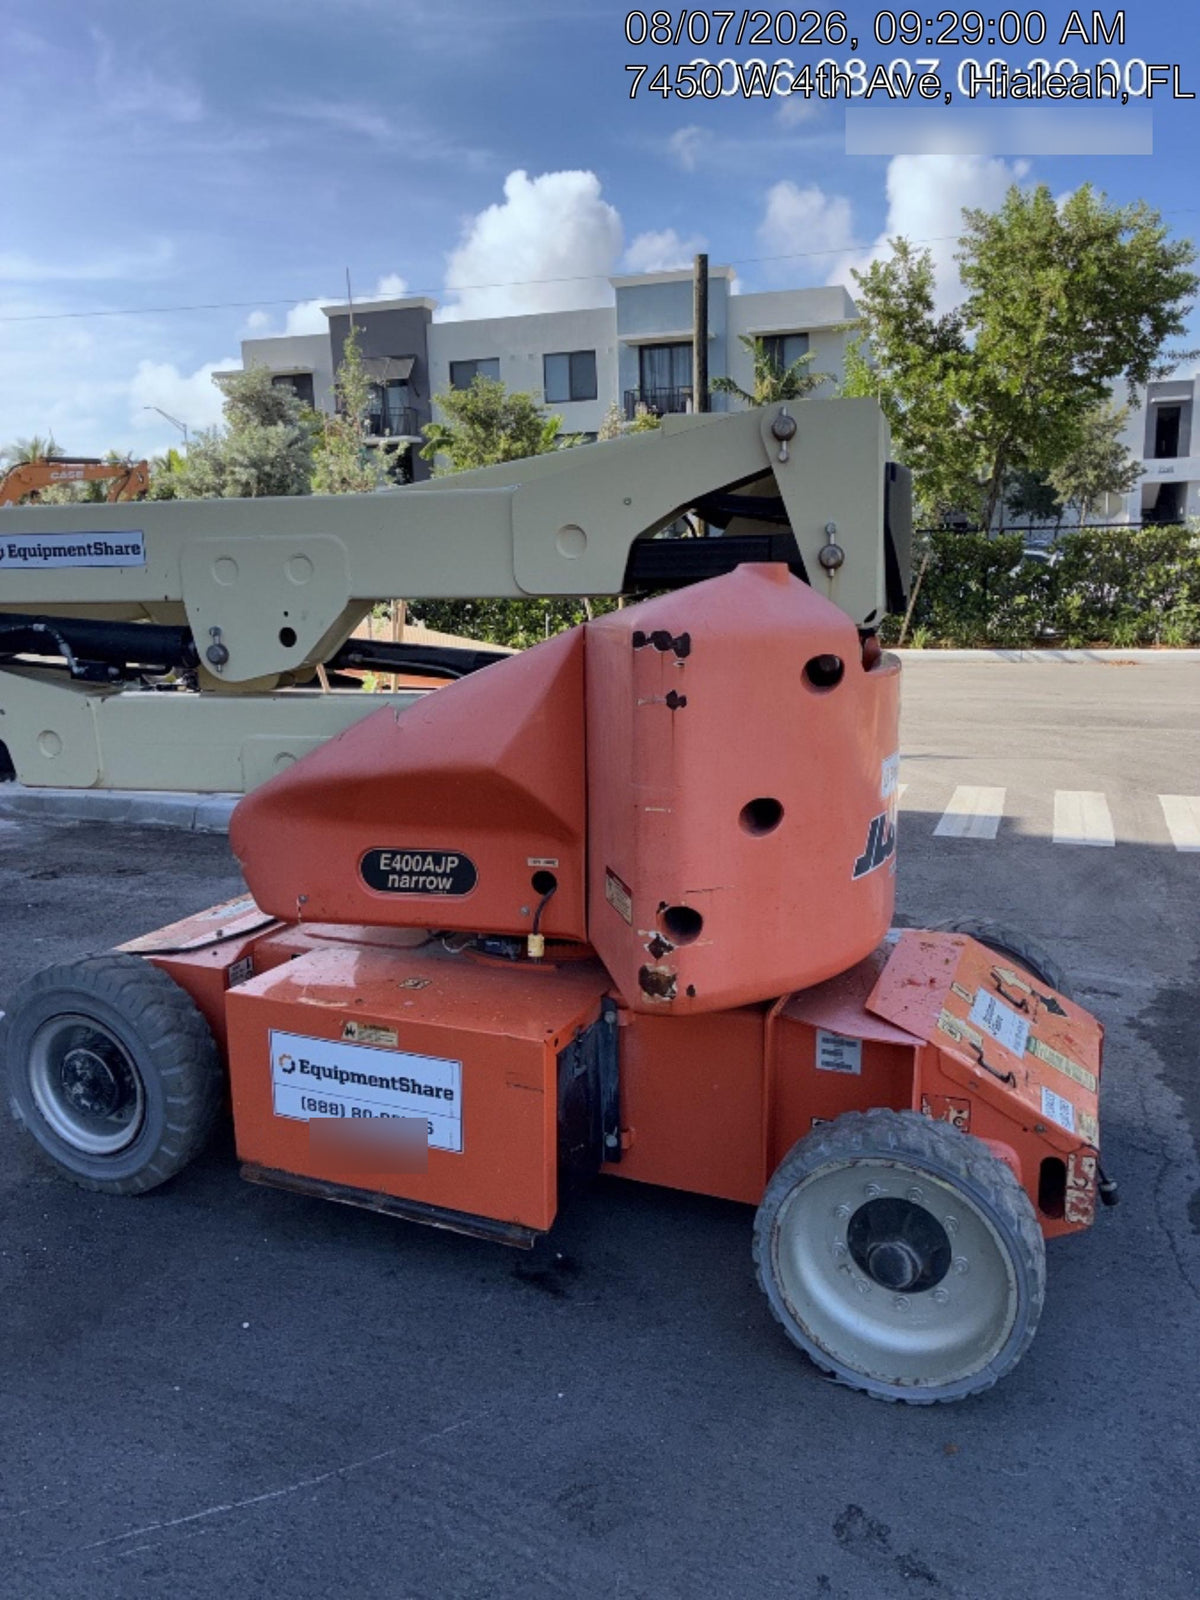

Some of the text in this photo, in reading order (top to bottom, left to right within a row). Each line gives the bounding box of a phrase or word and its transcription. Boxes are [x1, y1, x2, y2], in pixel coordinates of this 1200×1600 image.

[7, 541, 141, 560] EquipmentShare
[379, 853, 459, 874] E400AJP
[387, 873, 453, 890] narrow
[298, 1058, 454, 1101] EquipmentShare
[301, 1096, 346, 1118] (888)
